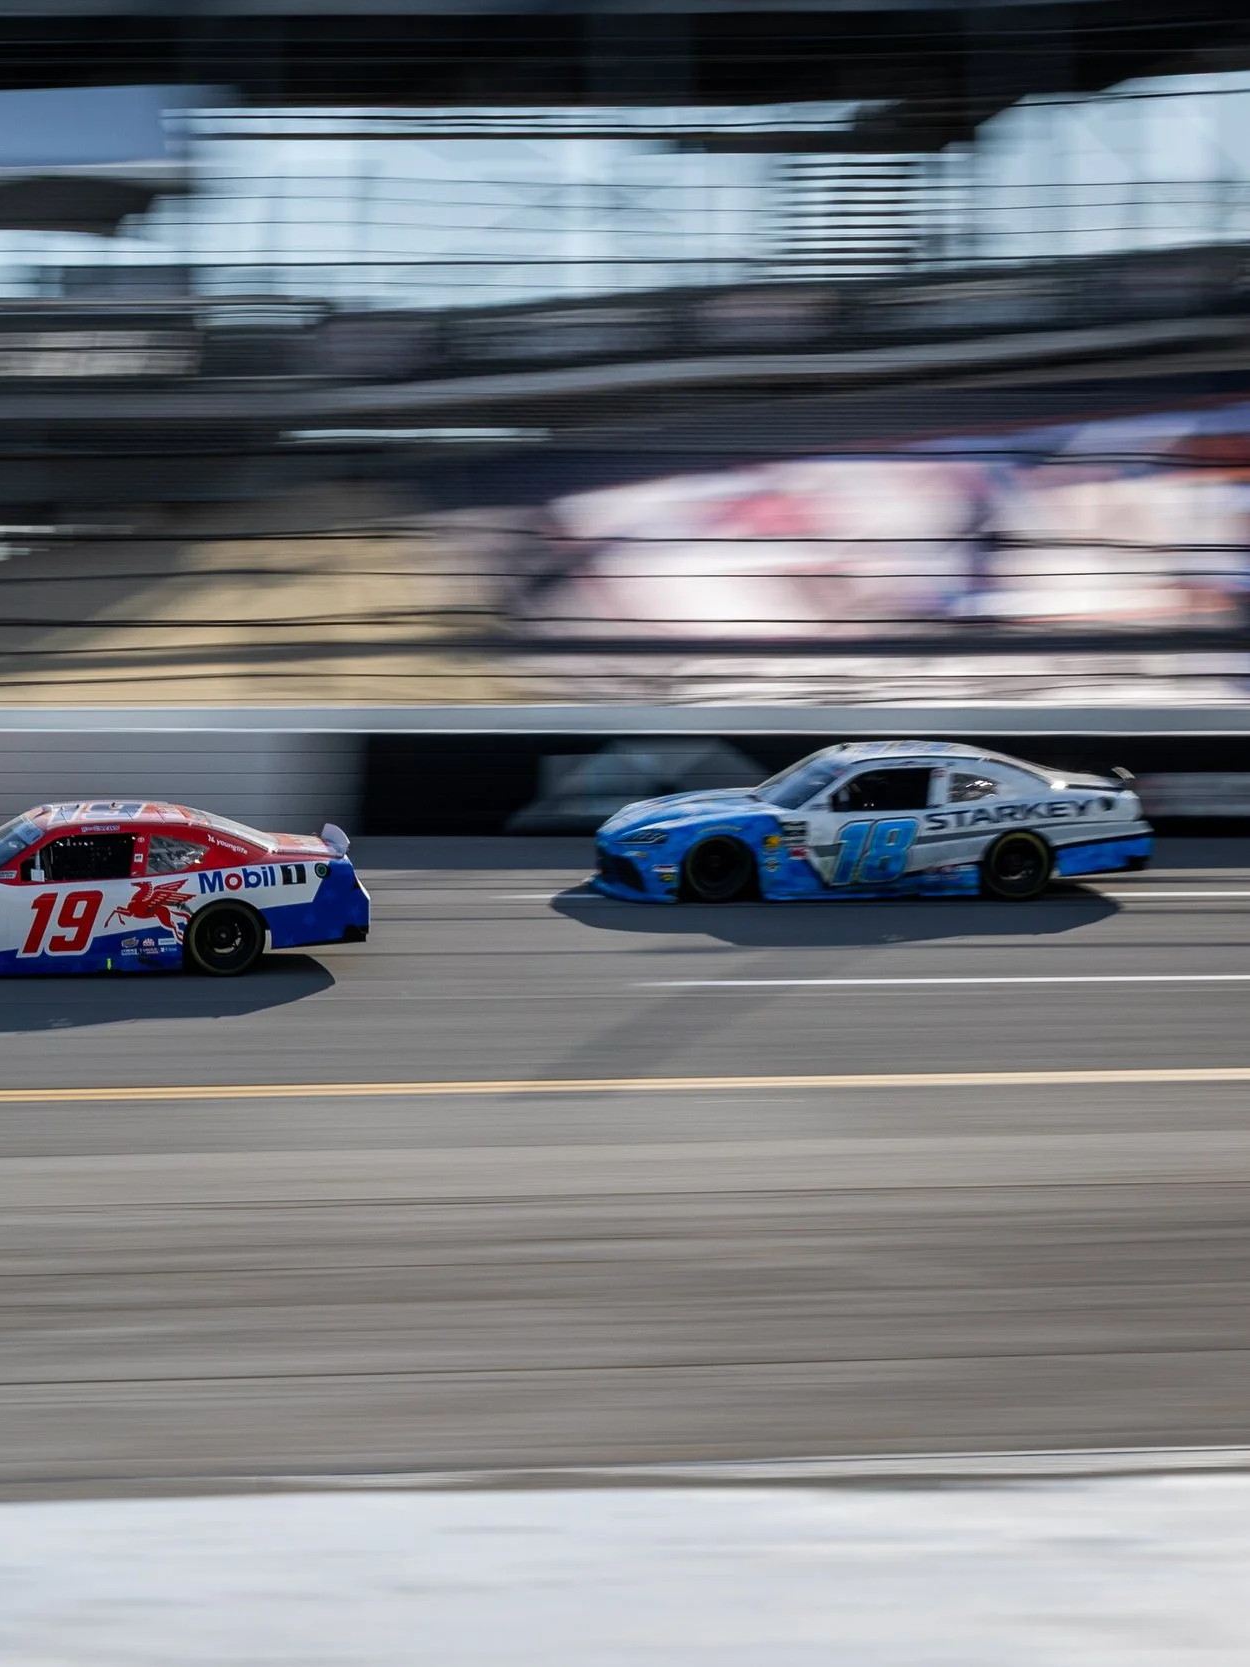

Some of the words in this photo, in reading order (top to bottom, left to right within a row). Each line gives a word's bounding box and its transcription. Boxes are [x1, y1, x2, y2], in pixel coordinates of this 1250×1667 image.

[924, 800, 1092, 831] STARKEY
[216, 839, 248, 855] younglife
[831, 817, 919, 886] 18
[198, 865, 276, 894] Mobil
[285, 864, 304, 885] 1
[18, 889, 104, 954] 19
